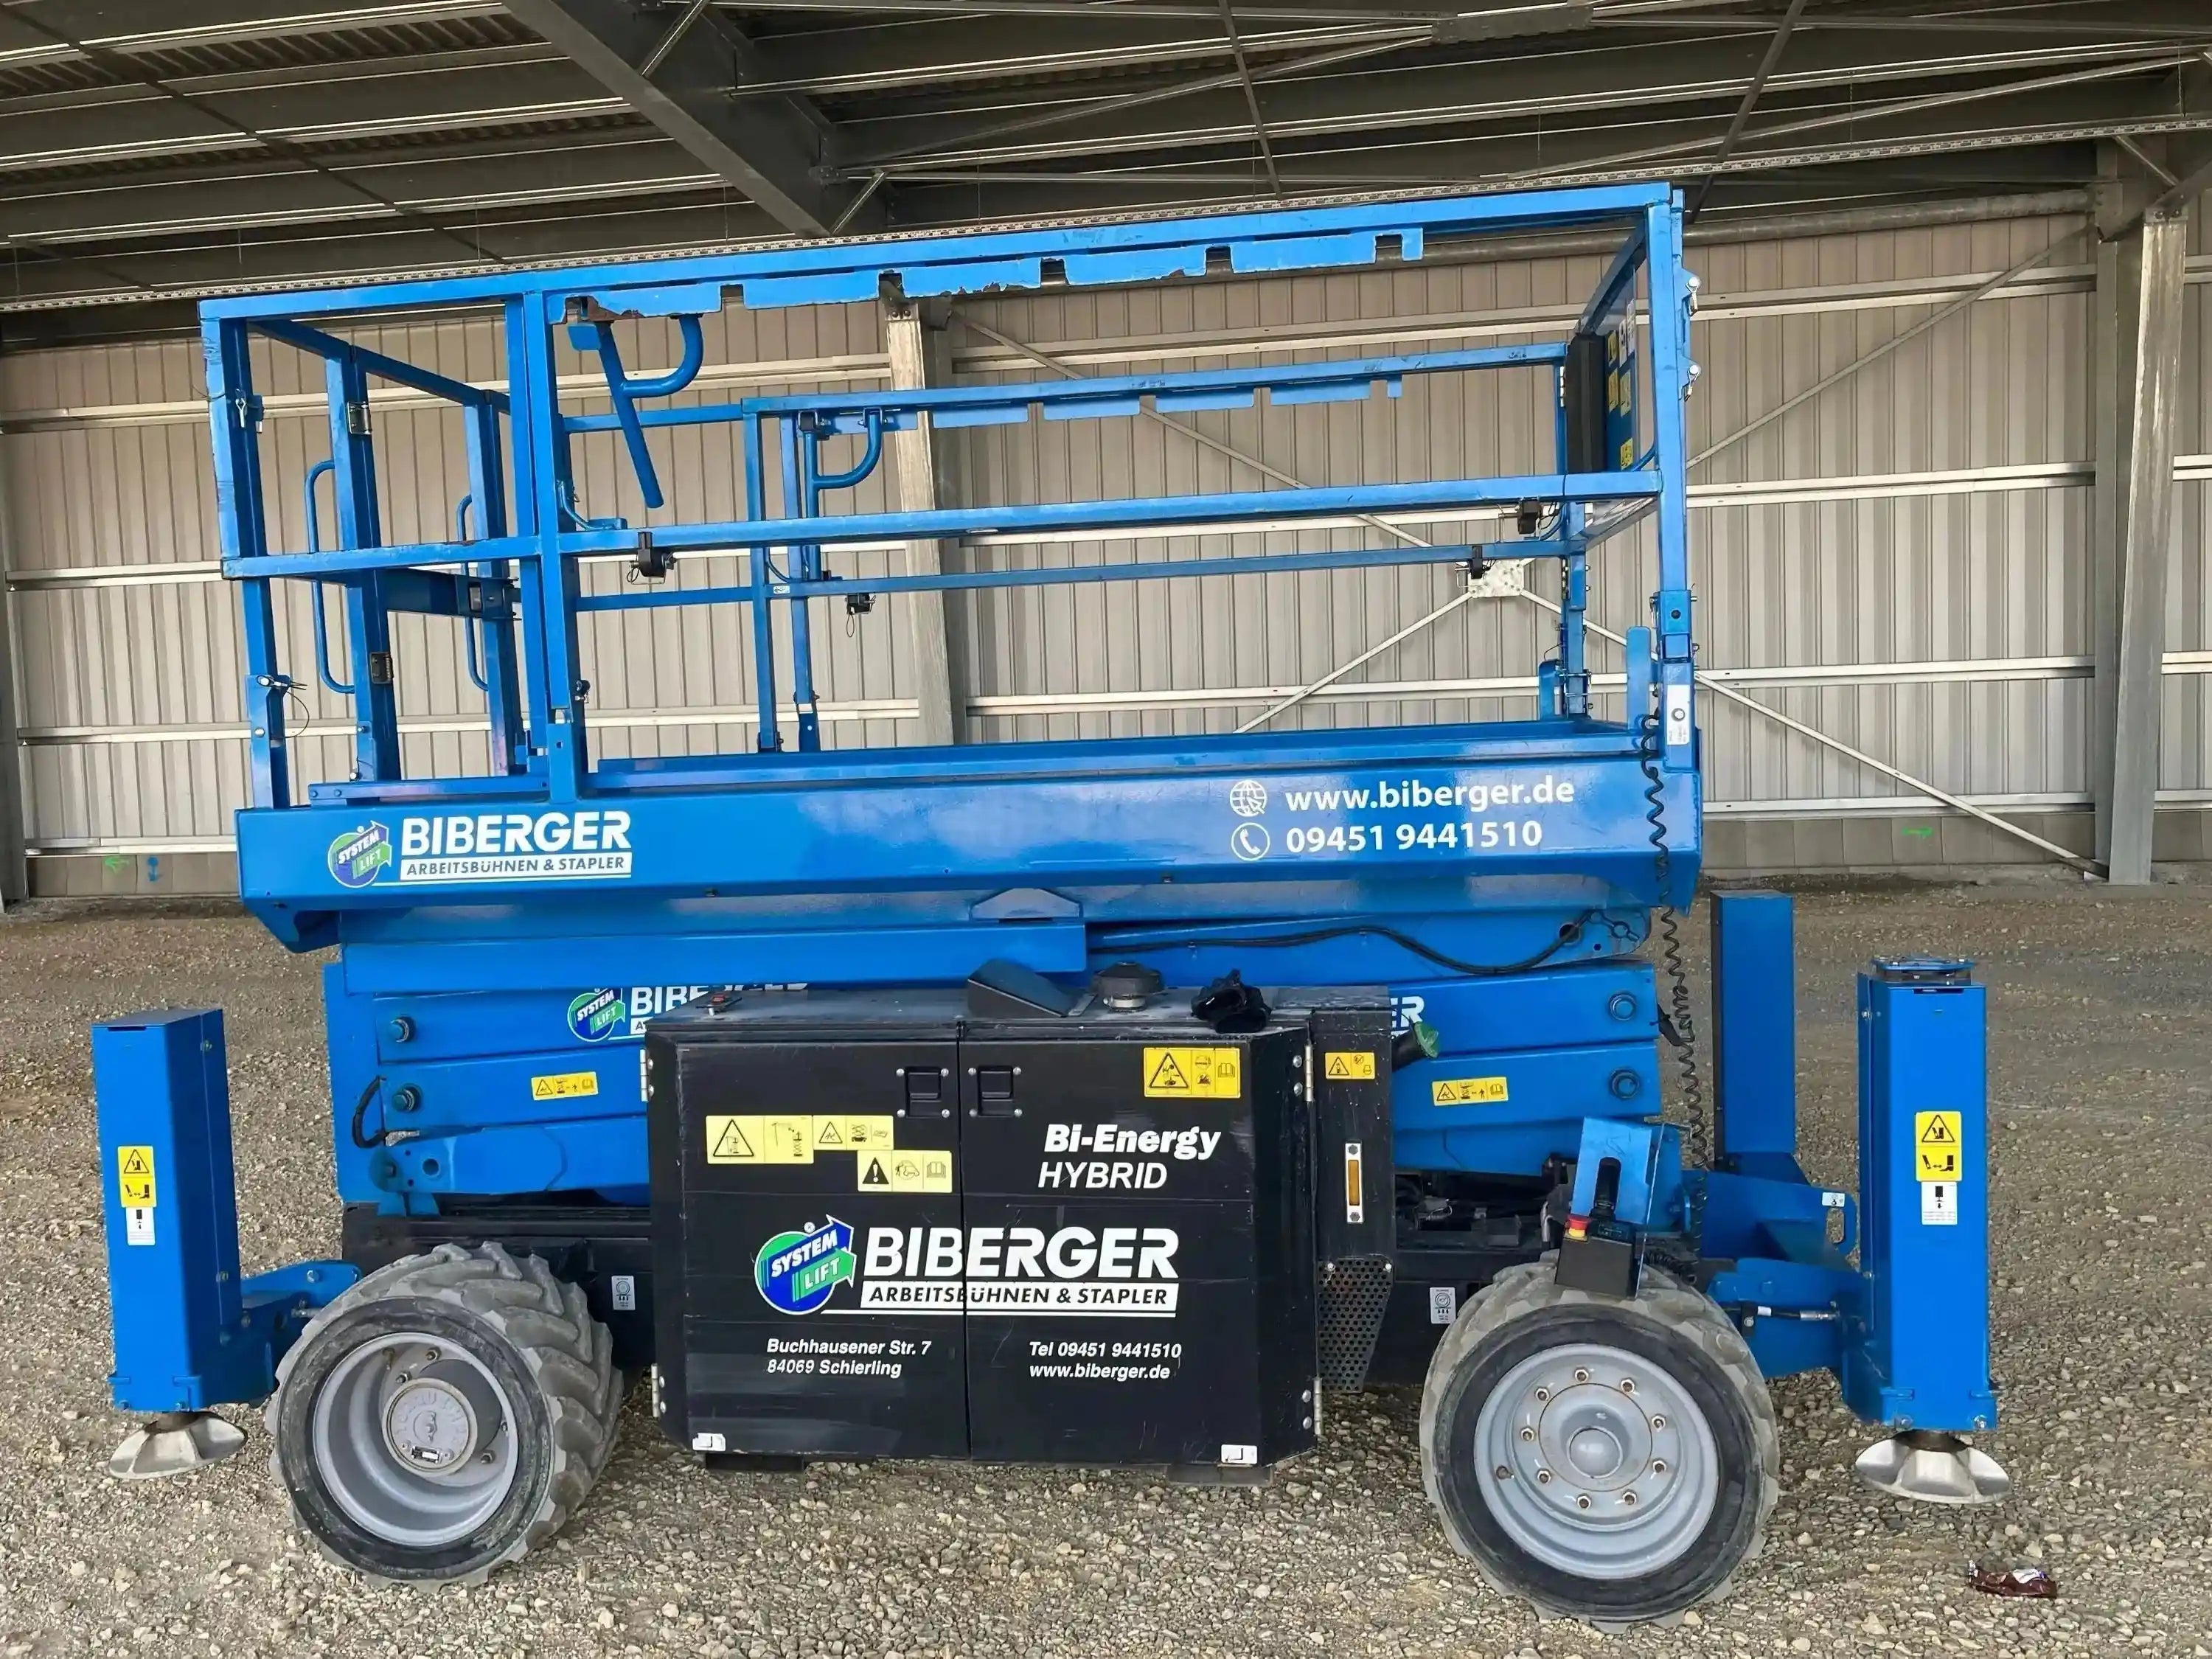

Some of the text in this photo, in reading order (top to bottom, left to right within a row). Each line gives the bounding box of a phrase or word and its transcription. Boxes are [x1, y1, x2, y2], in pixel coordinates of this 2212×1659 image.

[1285, 776, 1575, 813] www.biberger.de
[338, 829, 380, 865] SYSTEM
[400, 810, 632, 856] BIBERGER
[1286, 820, 1543, 854] 09451 9441510
[359, 848, 382, 872] LIFT
[406, 855, 625, 876] ARBEITSBÜHNEN & STAPLER
[577, 989, 615, 1022] SYSTEM
[596, 1006, 617, 1026] LIFT
[1043, 1123, 1222, 1161] Bi-Energy
[1037, 1161, 1169, 1189] HYBRID
[771, 1228, 838, 1278] SYSTEM
[863, 1226, 1179, 1279] BIBERGER
[804, 1256, 841, 1290] LIFT
[1056, 1287, 1071, 1304] &
[1077, 1287, 1168, 1305] STAPLER
[766, 1338, 932, 1356] Buchhausener Str. 7
[1029, 1340, 1183, 1359] Tel 09451 9441510
[767, 1359, 902, 1380] 84069 Schierling
[1029, 1364, 1171, 1382] www.biberger.de
